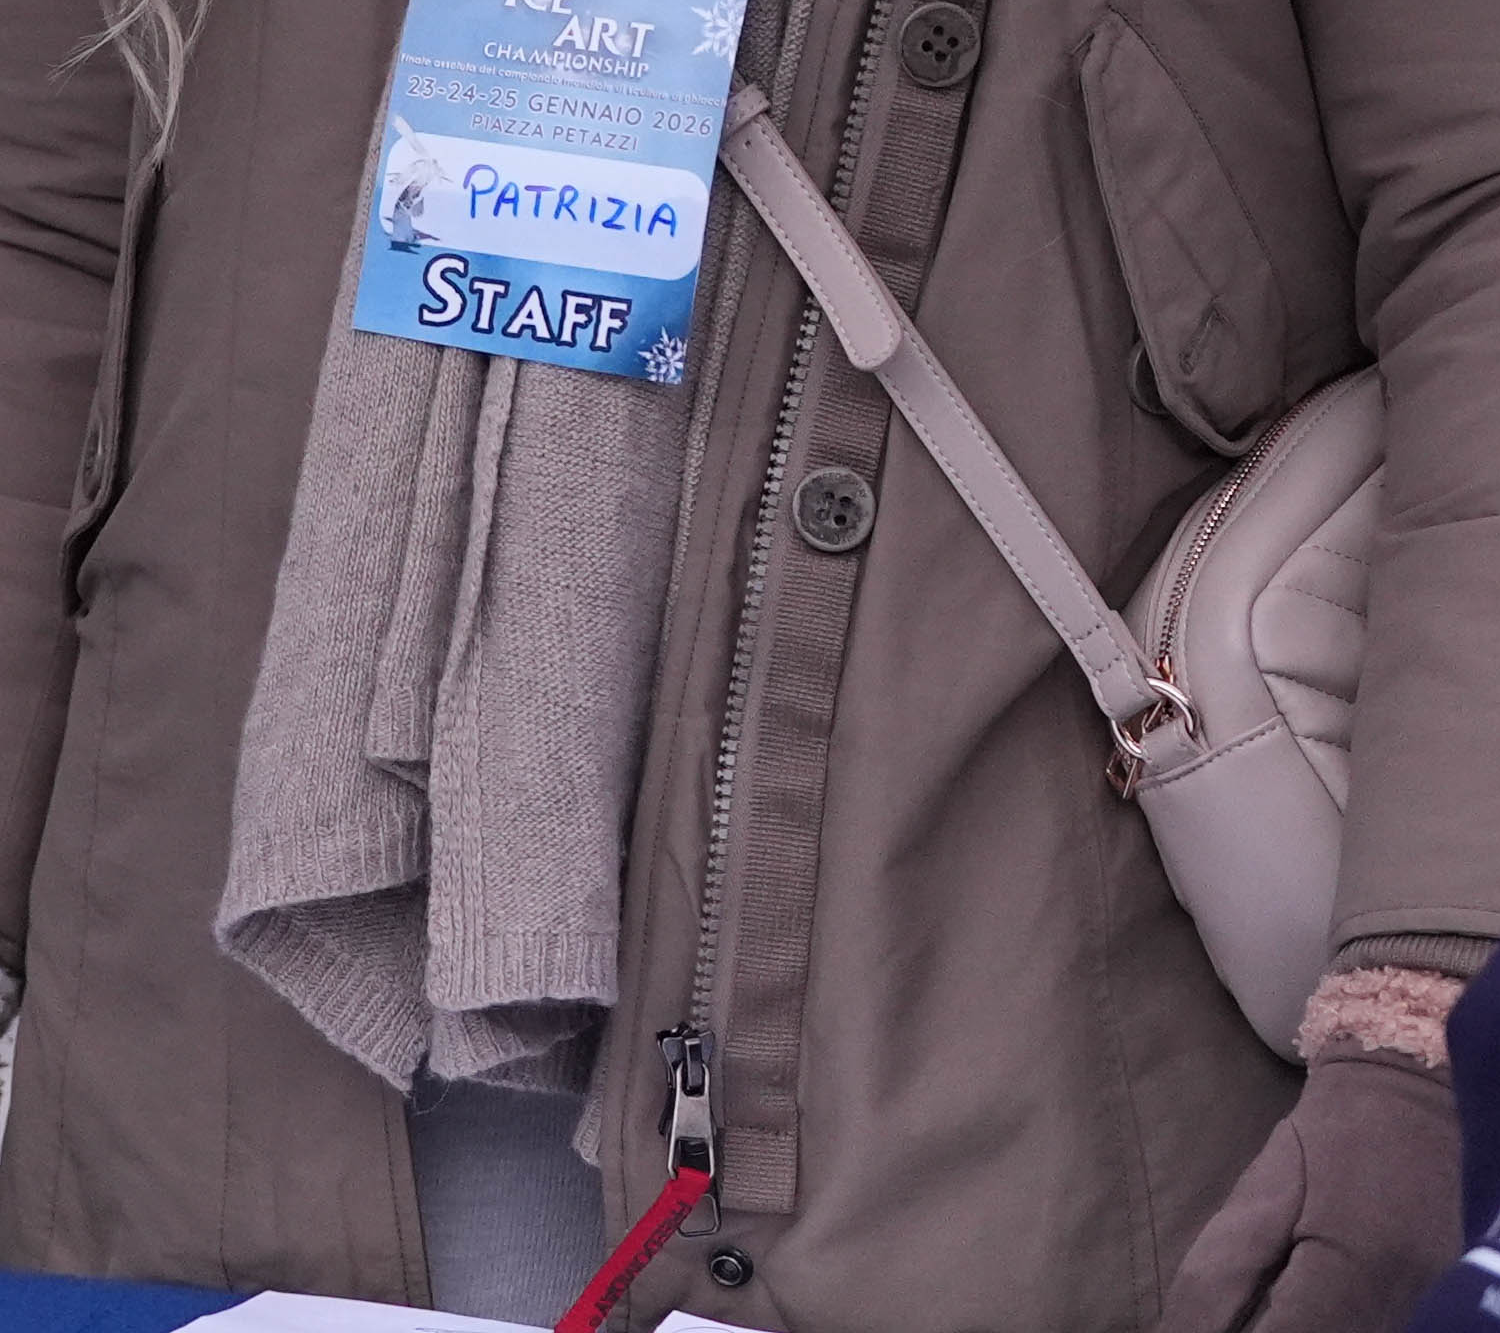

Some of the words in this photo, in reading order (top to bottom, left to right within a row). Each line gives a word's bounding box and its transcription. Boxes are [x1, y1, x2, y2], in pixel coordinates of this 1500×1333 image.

[483, 41, 649, 79] CHAMPIONSHIP
[553, 15, 656, 58] ART
[407, 76, 518, 109] 23-24-25
[528, 93, 642, 126] GENNAIO
[653, 110, 712, 137] 2026
[471, 113, 545, 139] PIAZZA
[552, 128, 639, 151] PETAZZI
[462, 163, 679, 237] PATRIZIA
[421, 256, 630, 351] STAFF
